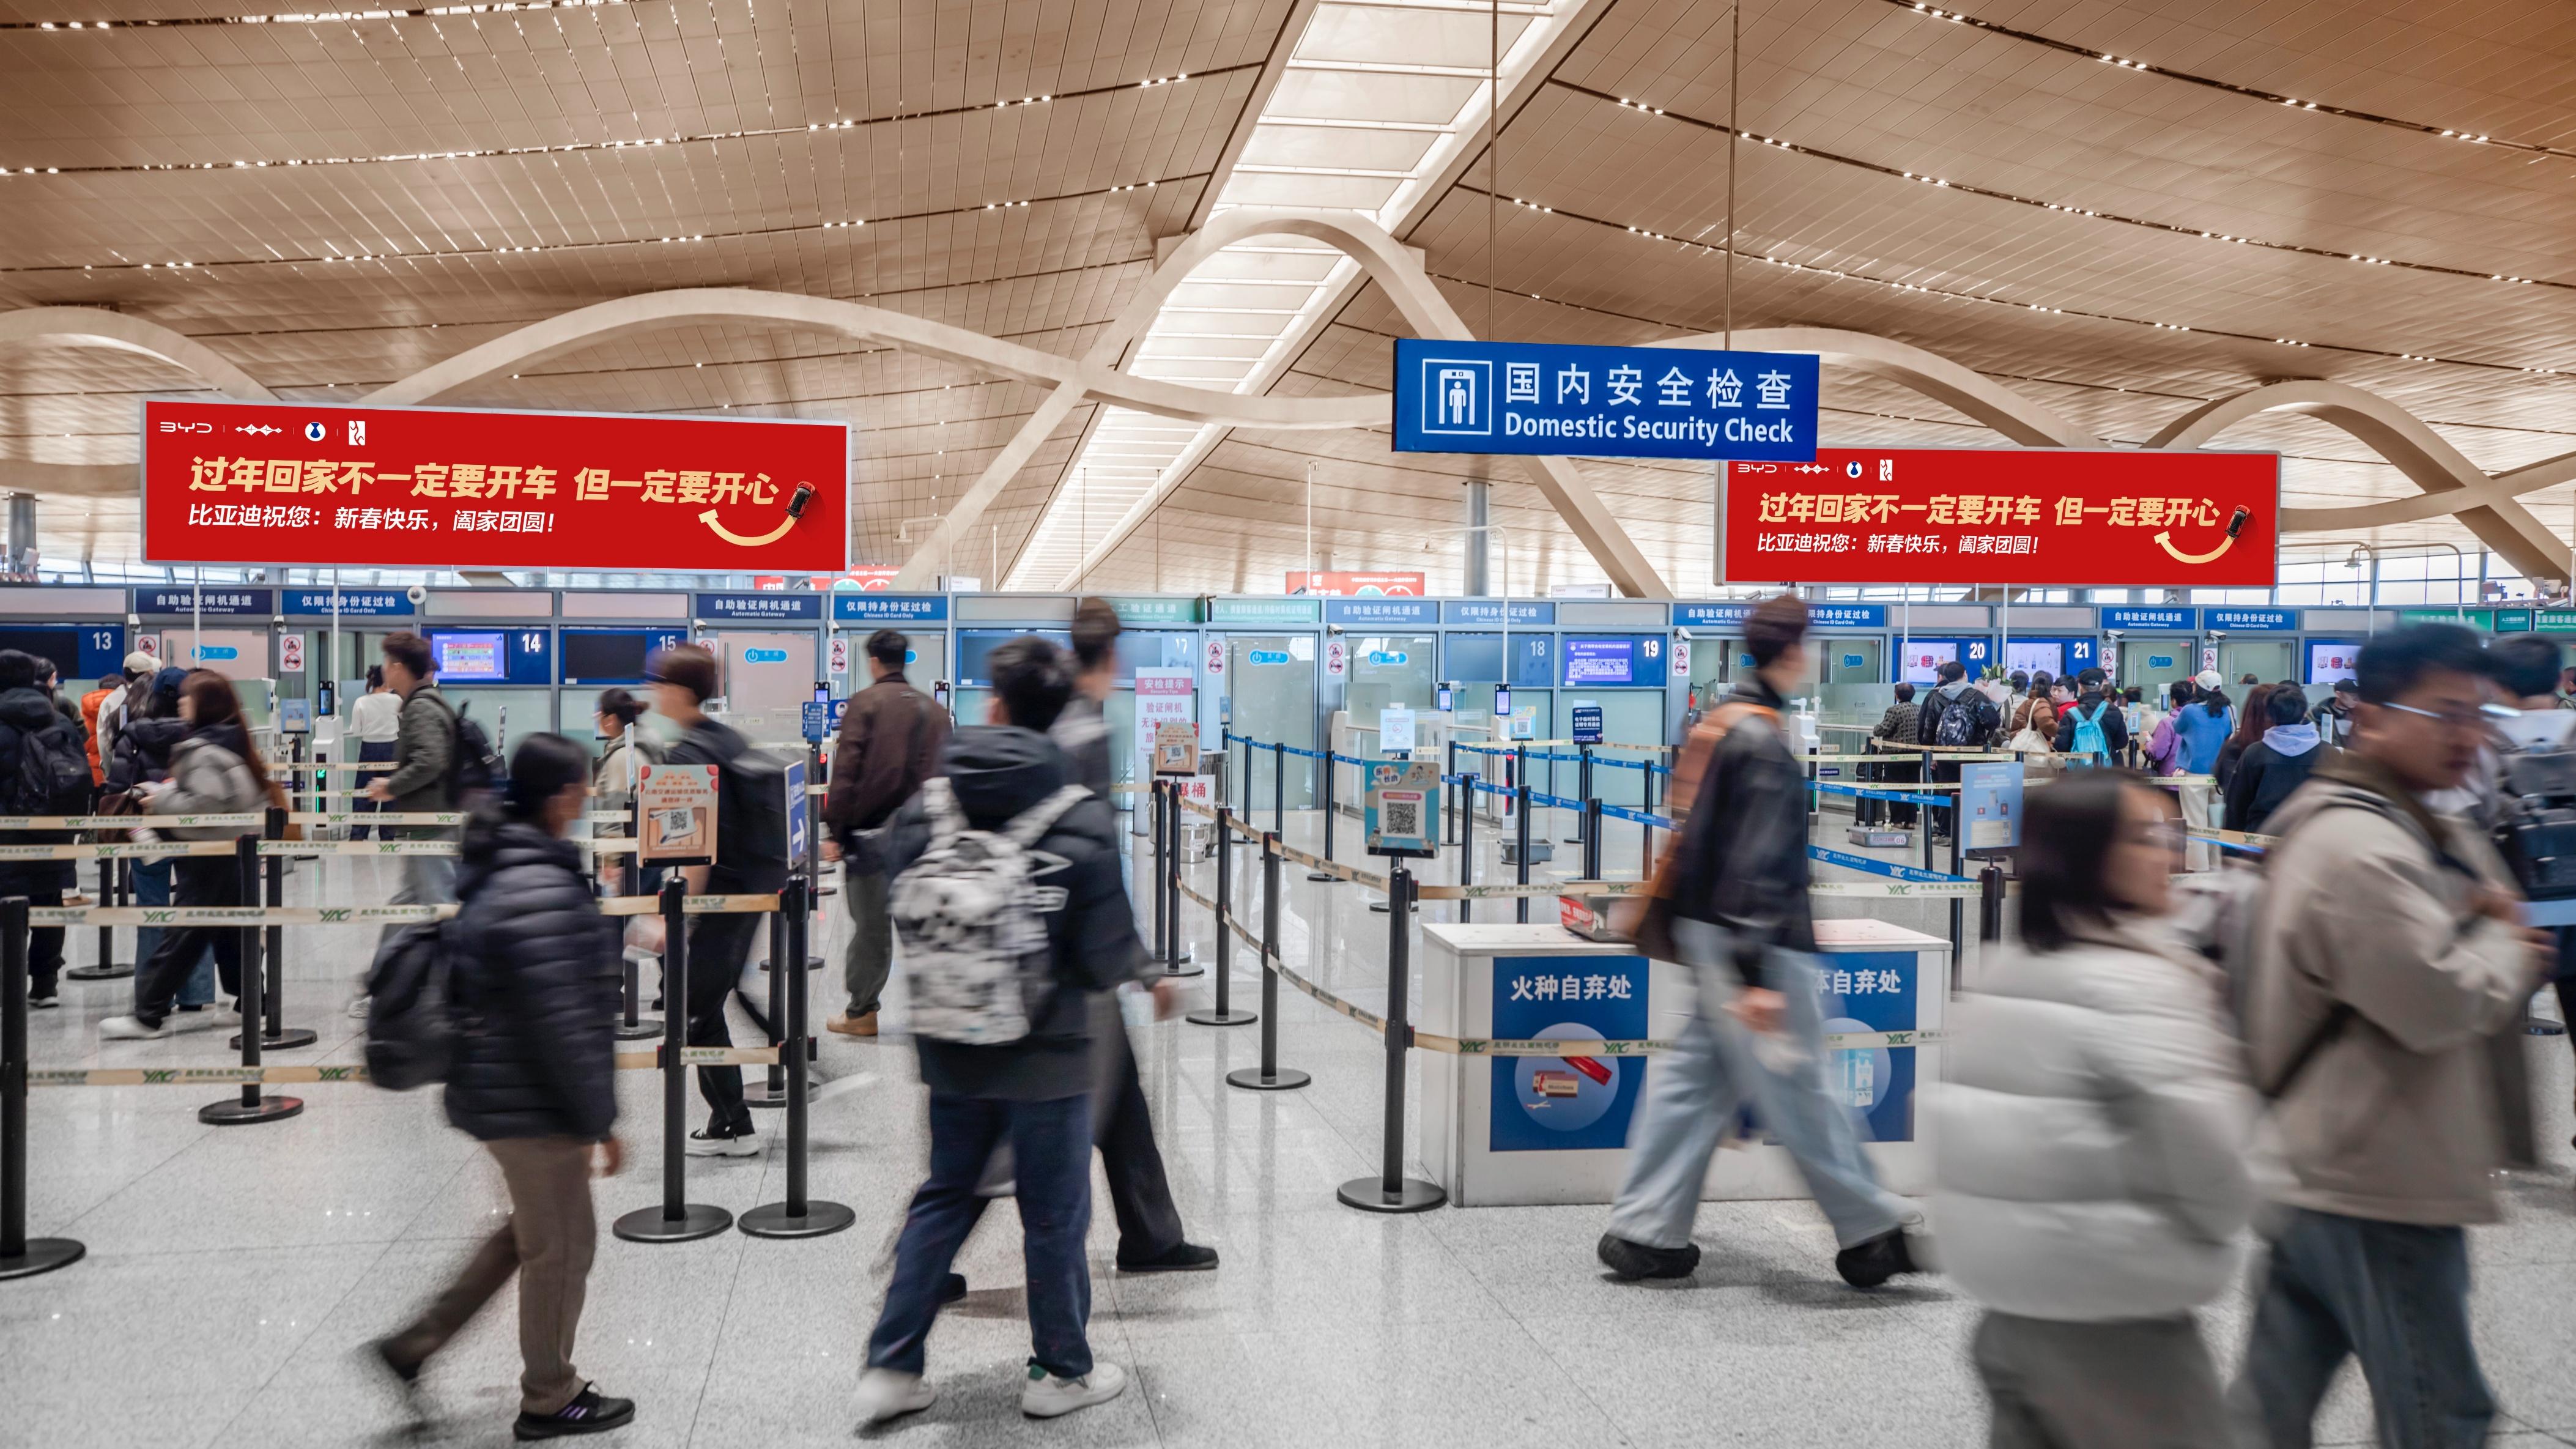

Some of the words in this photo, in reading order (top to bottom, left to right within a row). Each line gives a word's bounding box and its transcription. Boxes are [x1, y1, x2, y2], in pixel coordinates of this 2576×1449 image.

[1506, 362, 1792, 409] 国内安全检查
[160, 422, 213, 433] BYD
[1506, 412, 1616, 437] Domestic
[1624, 415, 1719, 446] Security
[1725, 418, 1793, 442] Check
[189, 456, 557, 501] 过年回家不一定要开车
[574, 467, 779, 505] 但一定要开心
[188, 503, 554, 533] 比亚迪祝您：新春快乐，阖家团圆！
[1758, 492, 2041, 525] 过年回家不一定要开车
[2054, 495, 2221, 528] 但一定要开心
[1757, 533, 2038, 555] 比亚迪祝您：新春快乐，阖家团圆！
[715, 599, 801, 611] 自助验证闸机通道
[846, 601, 931, 612] 仅限持身份证过检
[1111, 604, 1176, 613] 工验证通道
[1344, 606, 1420, 615] 自助验证闸机通道
[1689, 609, 1751, 618] 自助验证闸机通
[1808, 609, 1870, 620] 限持身份证过检
[2115, 612, 2182, 622] 自助验证闸机通道
[2216, 613, 2283, 623] 仅限持身份证过检
[93, 632, 112, 650] 13
[522, 633, 541, 653] 14
[659, 636, 676, 651] 15
[1530, 640, 1545, 656] 18
[1643, 640, 1659, 658] 19
[1969, 642, 1985, 659] 20
[2074, 642, 2089, 658] 21
[1144, 679, 1184, 689] 安检提示
[1146, 702, 1183, 713] 验证闸机
[1180, 782, 1206, 798] 爆桶
[1511, 974, 1632, 1001] 火种自弃处
[1815, 969, 1901, 995] 体自弃处
